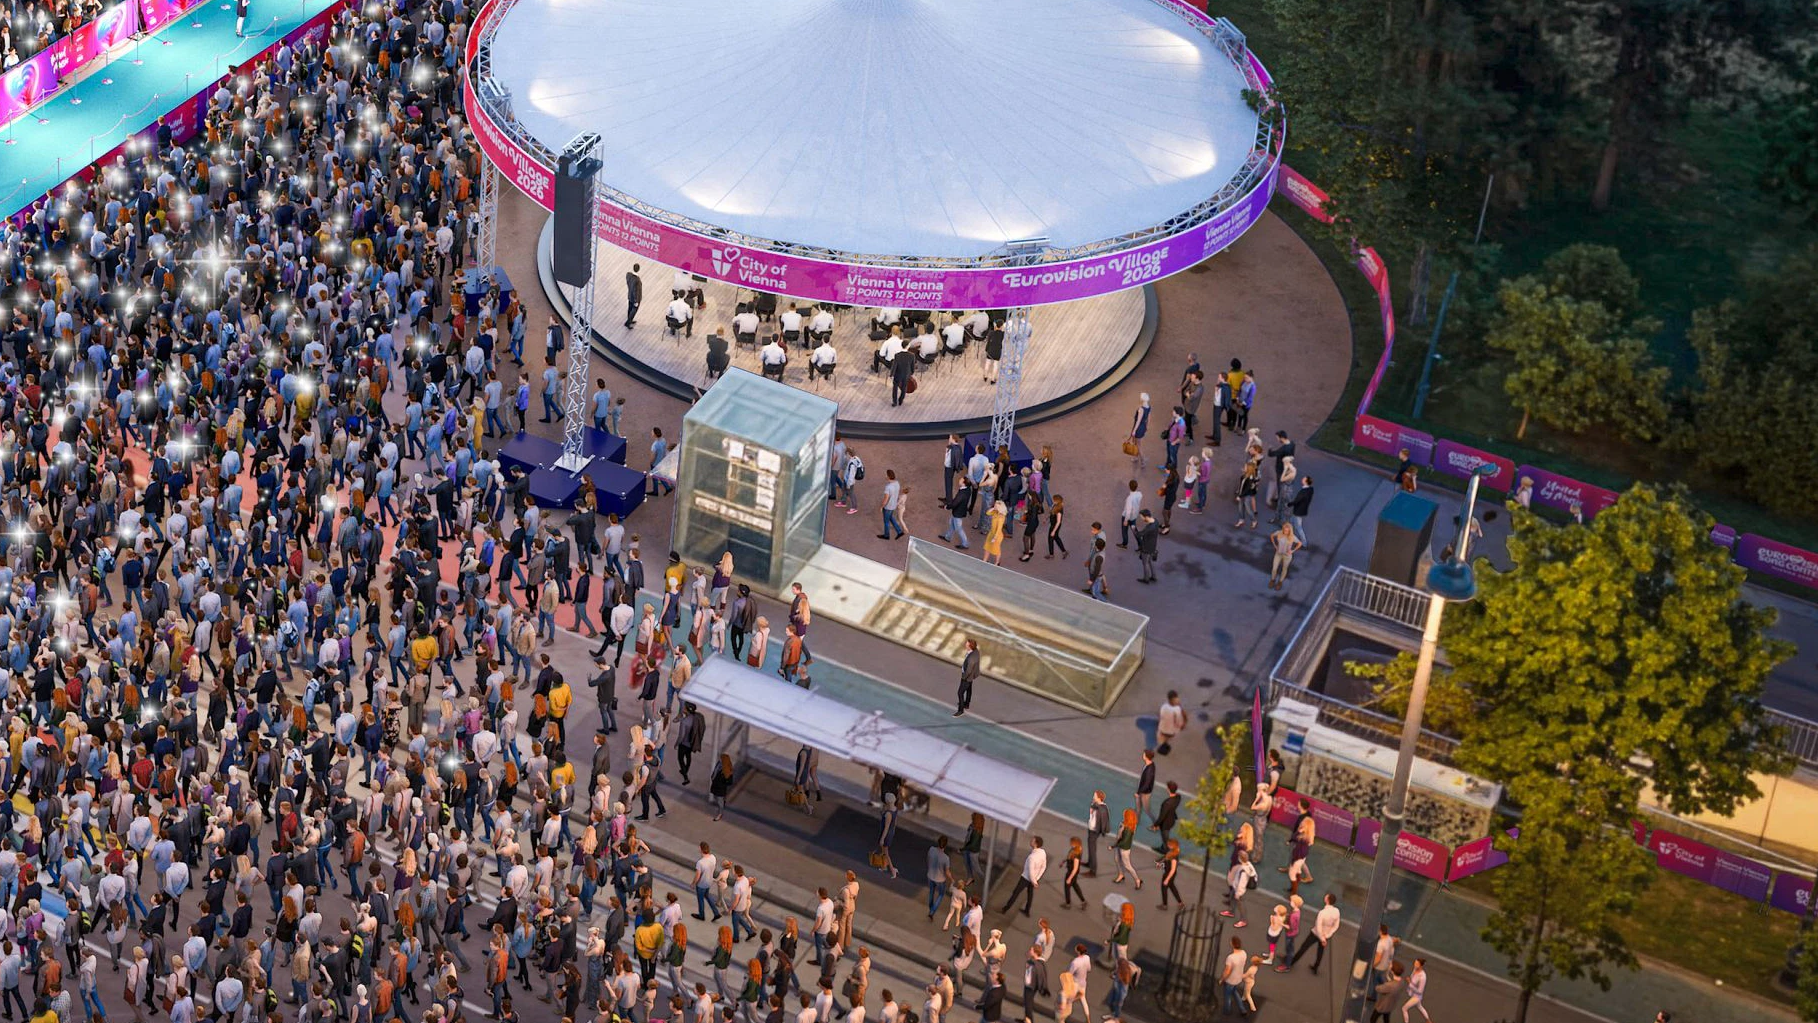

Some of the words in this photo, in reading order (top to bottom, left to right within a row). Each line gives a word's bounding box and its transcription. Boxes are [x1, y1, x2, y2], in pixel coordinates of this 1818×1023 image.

[508, 147, 550, 190] Village
[517, 170, 545, 200] 2026
[622, 218, 661, 243] Vienna
[629, 233, 660, 253] POINTS
[739, 256, 769, 276] City
[770, 264, 787, 276] of
[1002, 263, 1106, 288] Eurovision
[1108, 246, 1170, 272] Village
[1121, 263, 1162, 286] 2026
[737, 268, 787, 290] Vienna
[847, 274, 895, 289] Vienna
[896, 277, 944, 291] Vienna
[846, 287, 856, 296] 12
[857, 288, 894, 299] POINTS
[895, 291, 905, 300] 12
[906, 291, 943, 301] POINTS
[1546, 481, 1582, 497] United
[1786, 562, 1818, 578] CONTE
[1675, 853, 1705, 868] Vienna
[1676, 848, 1694, 860] City
[1694, 854, 1706, 862] of
[1716, 856, 1742, 870] Vienna
[1742, 866, 1770, 880] Vienna
